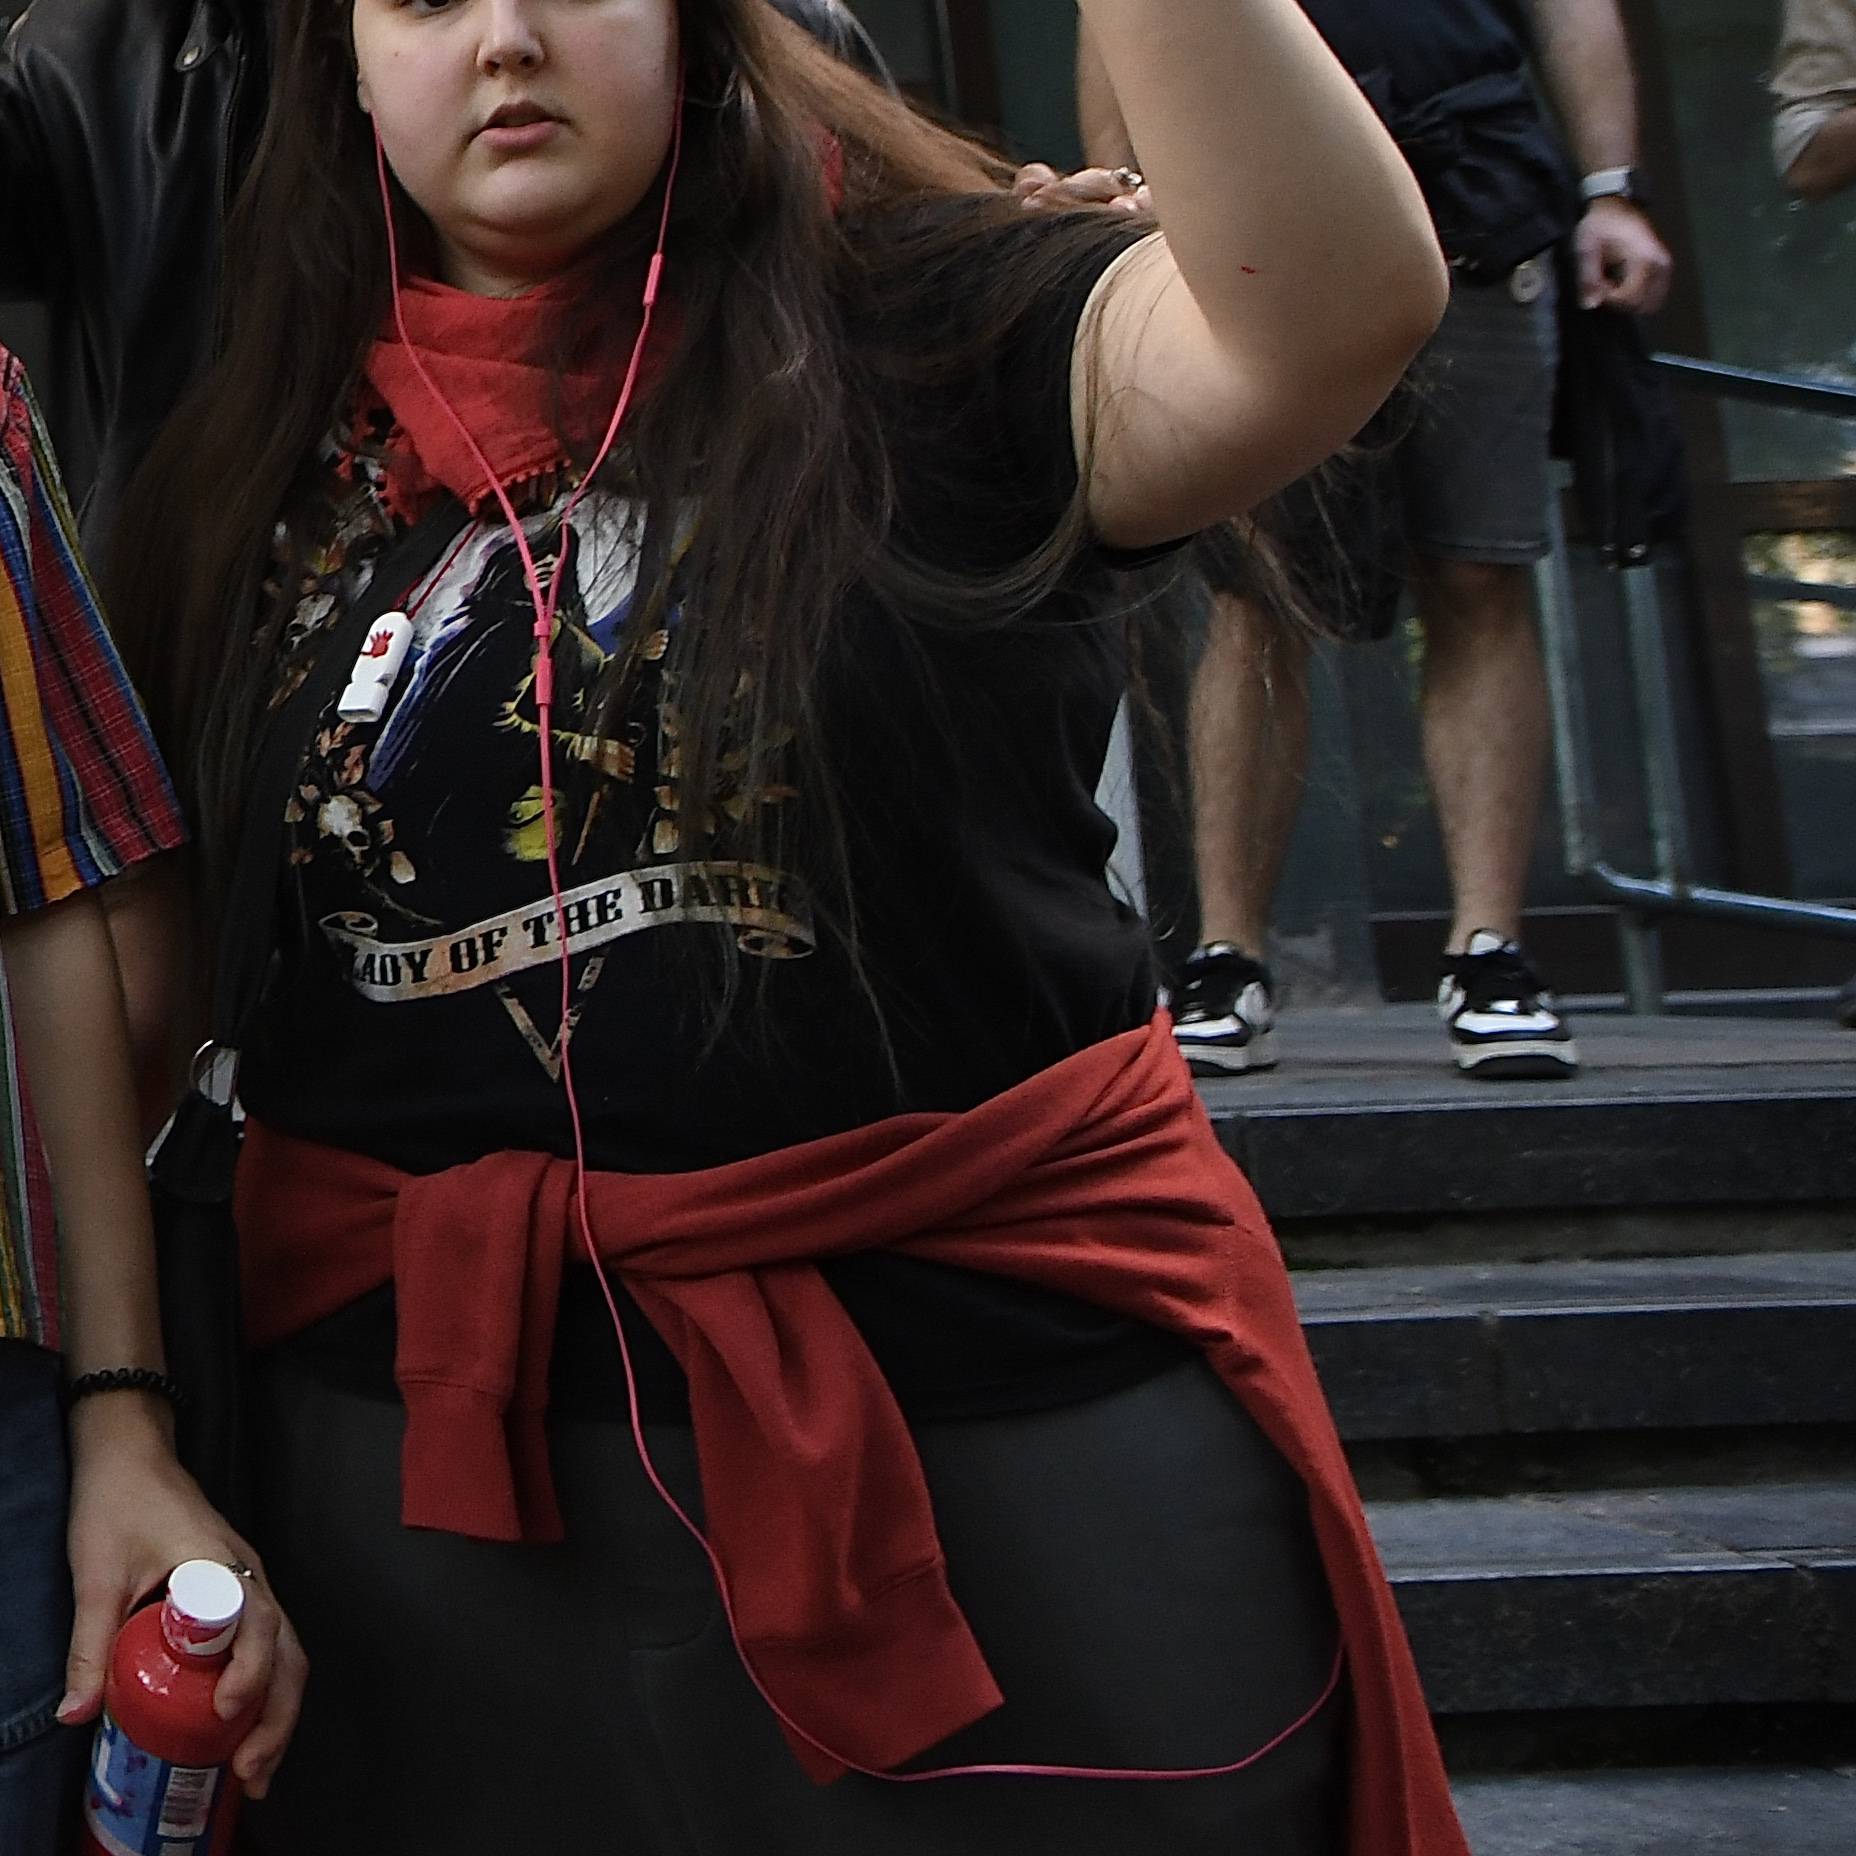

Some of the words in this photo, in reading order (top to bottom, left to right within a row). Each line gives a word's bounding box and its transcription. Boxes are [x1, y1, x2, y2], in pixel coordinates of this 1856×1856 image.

[358, 947, 433, 987] ADY
[449, 926, 508, 974] OF
[522, 887, 623, 949] THE
